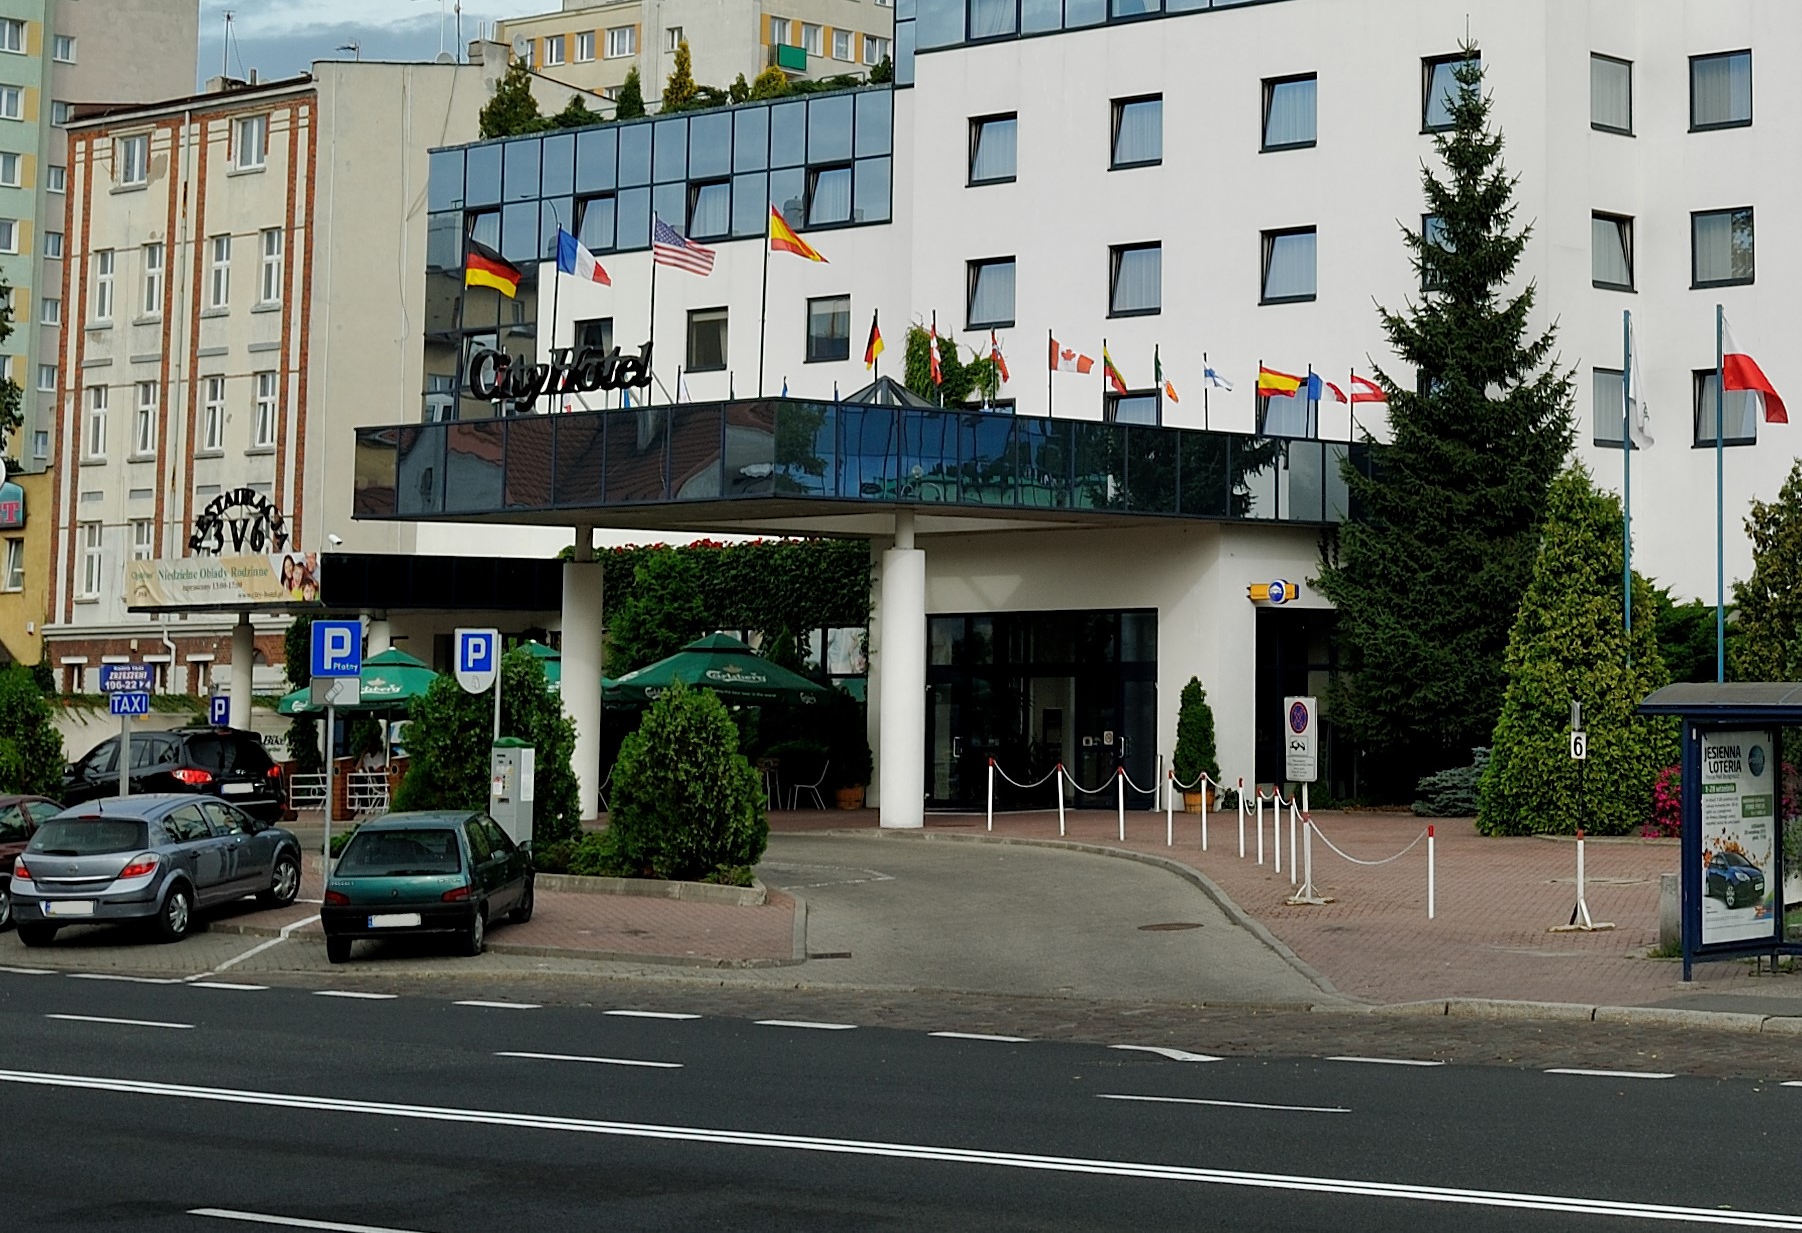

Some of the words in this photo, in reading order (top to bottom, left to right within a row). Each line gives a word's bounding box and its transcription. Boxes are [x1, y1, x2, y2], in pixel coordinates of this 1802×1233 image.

[470, 342, 653, 412] CityHotel
[158, 568, 197, 581] Niedzielne
[199, 567, 228, 579] Obiady
[231, 566, 268, 578] Rodzinne
[323, 627, 352, 670] P
[467, 637, 487, 668] P
[706, 669, 767, 684] Carlsberg
[111, 695, 146, 713] TAXI
[214, 698, 226, 722] P
[1573, 736, 1583, 757] 6
[1704, 745, 1742, 762] JESIENNA
[1709, 760, 1742, 774] LOTERIA
